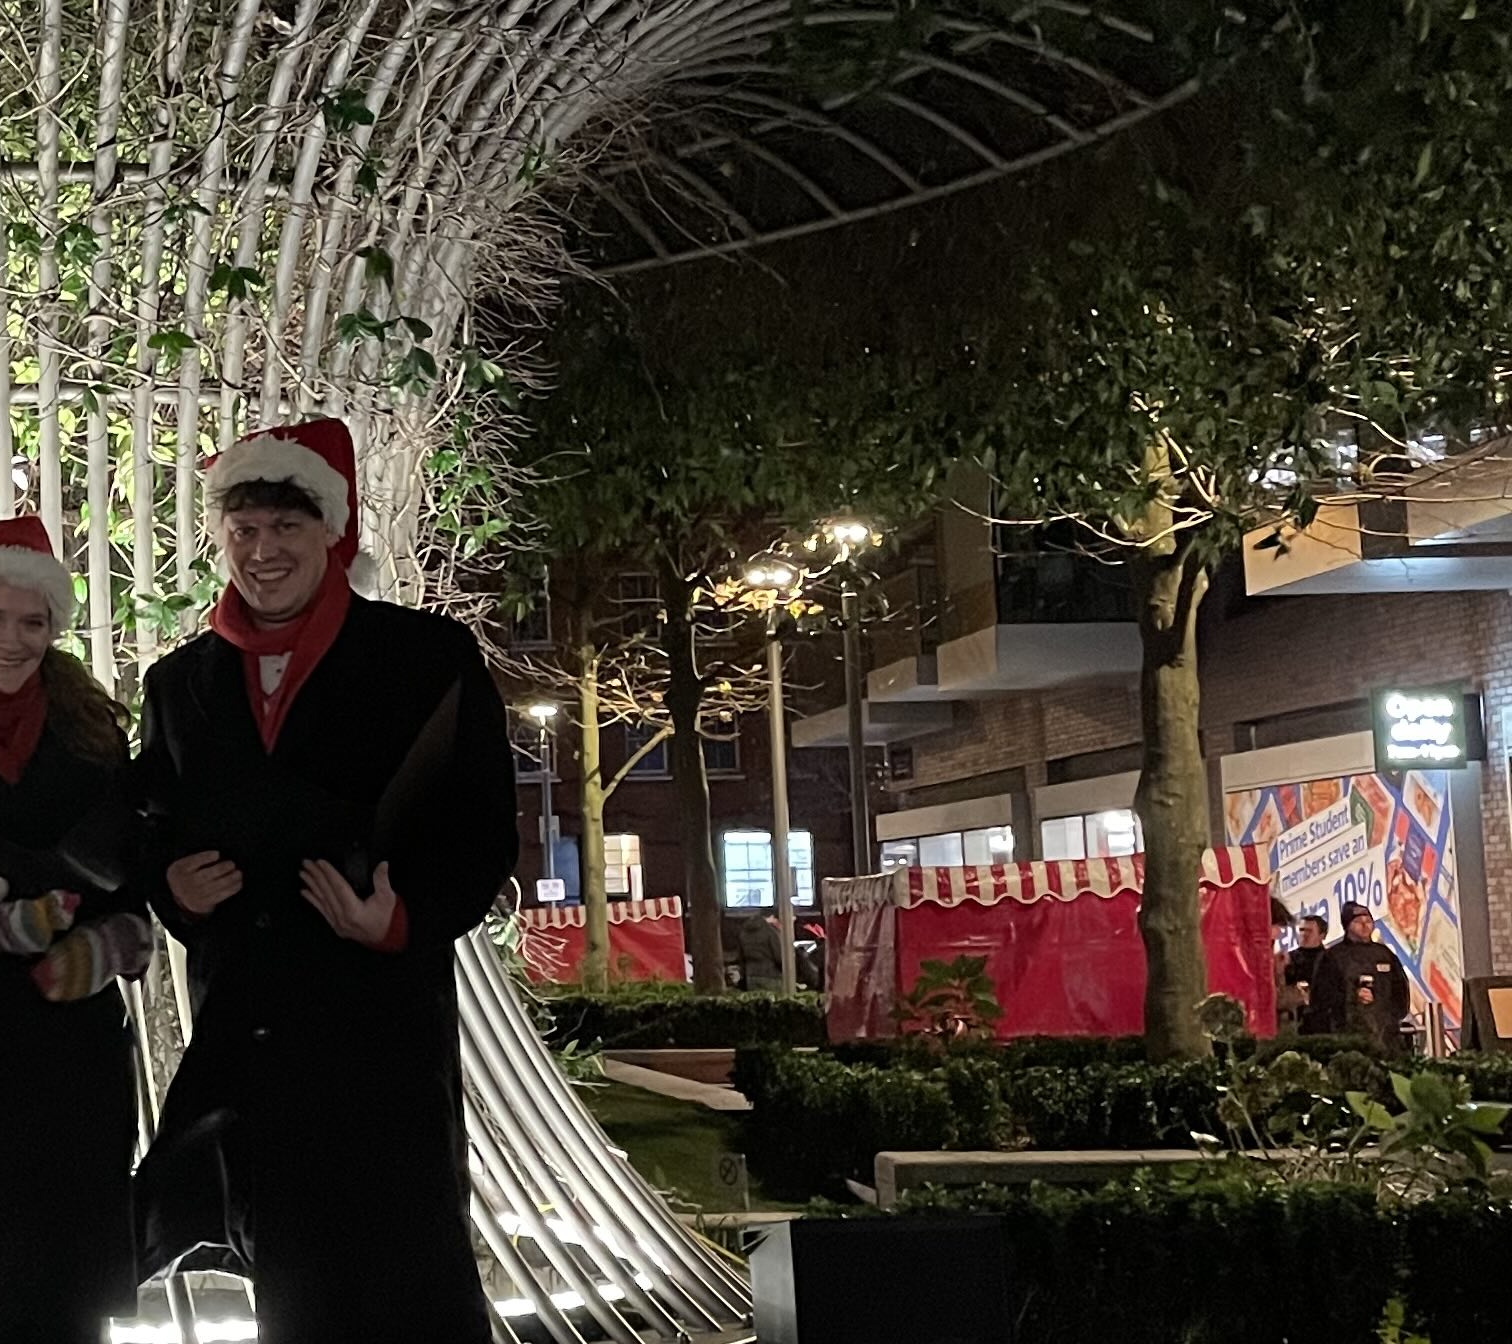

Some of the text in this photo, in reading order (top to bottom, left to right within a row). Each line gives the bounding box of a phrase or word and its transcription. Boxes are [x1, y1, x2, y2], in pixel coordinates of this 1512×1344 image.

[1279, 805, 1349, 861] Prime Student
[1281, 835, 1365, 892] members save an
[1333, 861, 1383, 912] 10%
